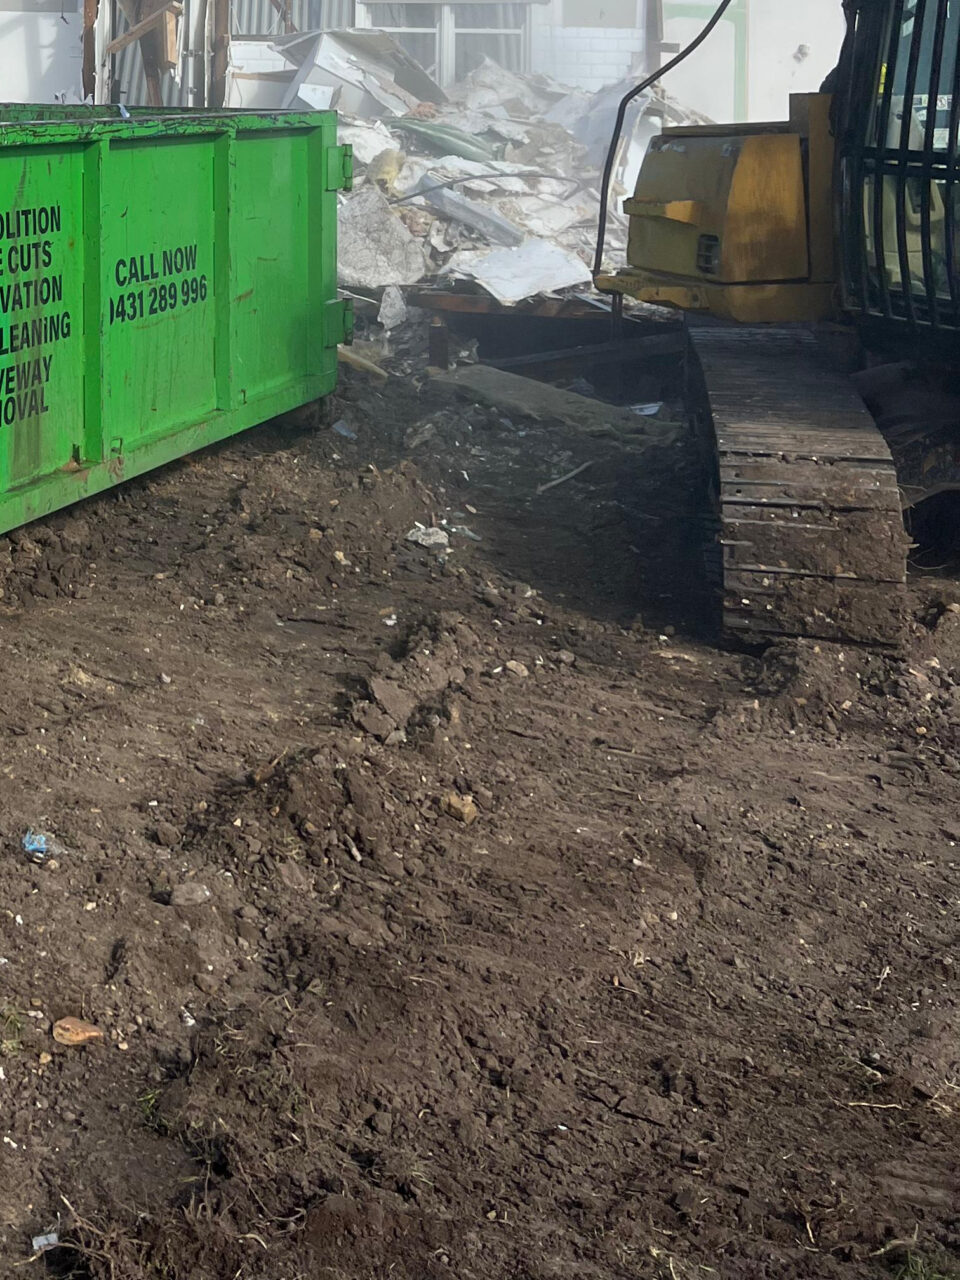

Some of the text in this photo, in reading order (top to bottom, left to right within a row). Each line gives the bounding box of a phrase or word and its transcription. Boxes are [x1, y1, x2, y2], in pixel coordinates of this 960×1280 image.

[7, 240, 52, 274] CUTS
[115, 244, 197, 287] CALL NOW
[148, 282, 177, 316] 289
[181, 274, 207, 305] 996
